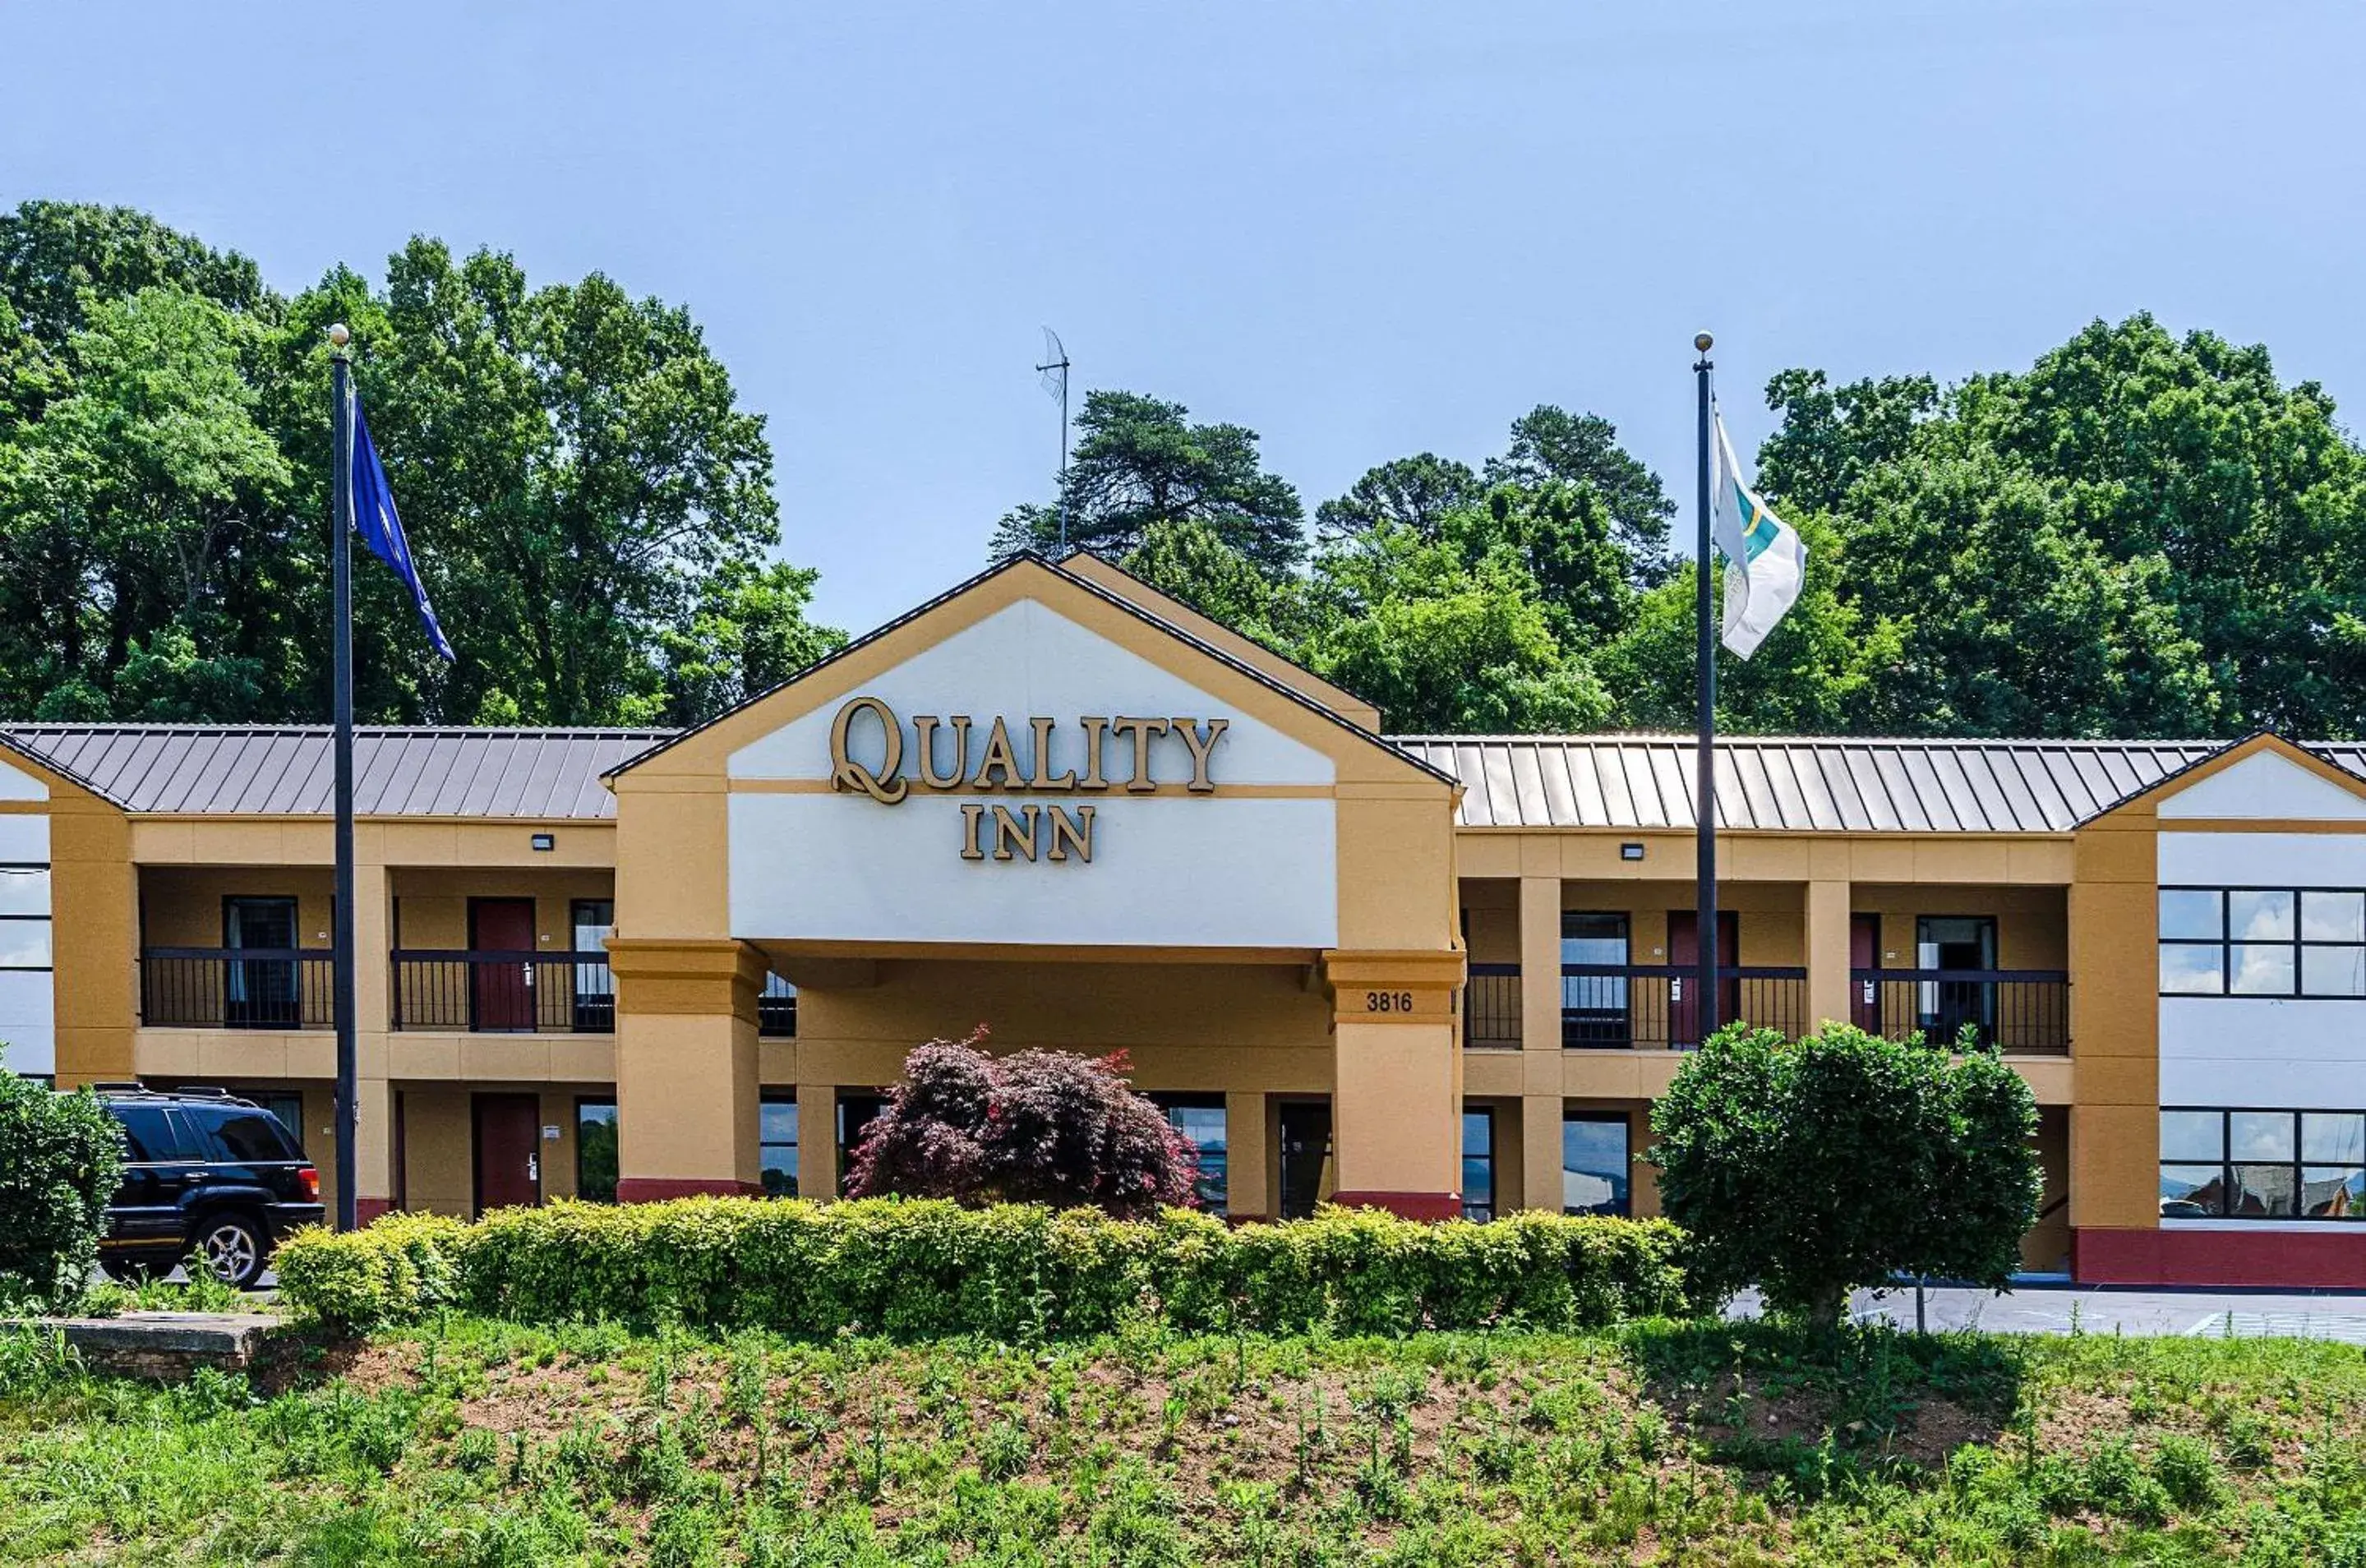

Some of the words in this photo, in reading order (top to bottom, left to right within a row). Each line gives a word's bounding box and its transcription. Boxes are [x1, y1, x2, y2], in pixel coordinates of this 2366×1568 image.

[829, 697, 1229, 805] QUALITY
[960, 804, 1095, 862] INN
[1367, 992, 1412, 1012] 3816
